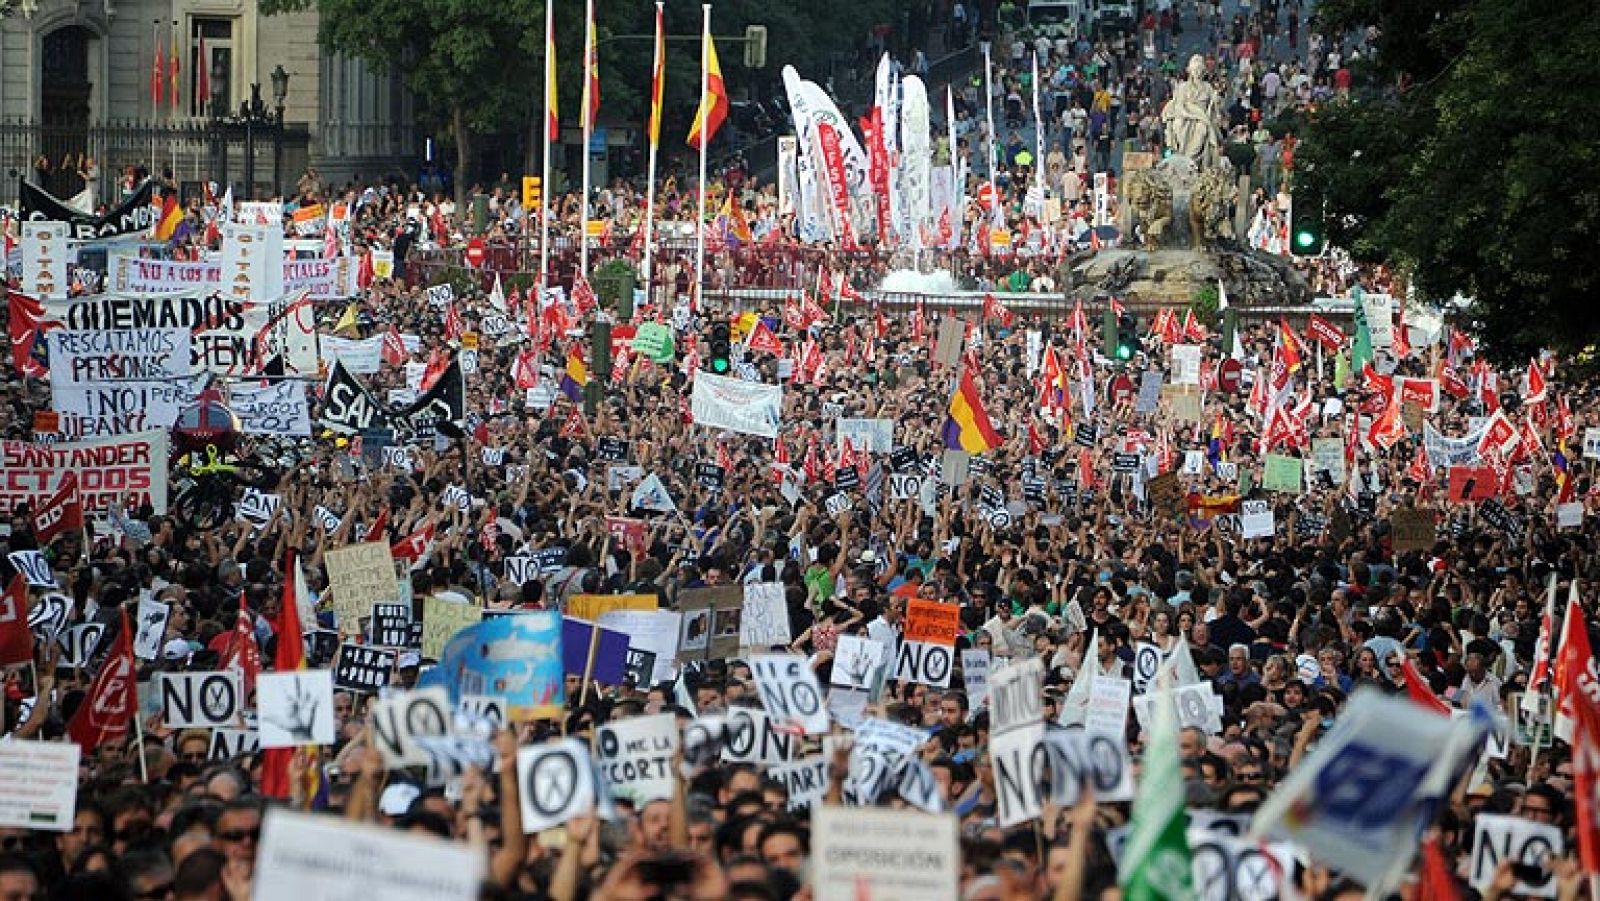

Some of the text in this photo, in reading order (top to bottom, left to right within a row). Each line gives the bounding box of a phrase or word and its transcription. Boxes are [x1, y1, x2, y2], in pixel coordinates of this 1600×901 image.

[58, 330, 176, 354] RESCATAMOS
[3, 439, 150, 468] SANTANDER
[889, 475, 920, 498] NO
[505, 558, 539, 584] NO
[57, 625, 103, 663] NO
[897, 642, 949, 682] NO
[161, 675, 236, 723] NO
[761, 681, 819, 716] NO
[373, 699, 447, 756] NO
[1476, 829, 1552, 888] NO
